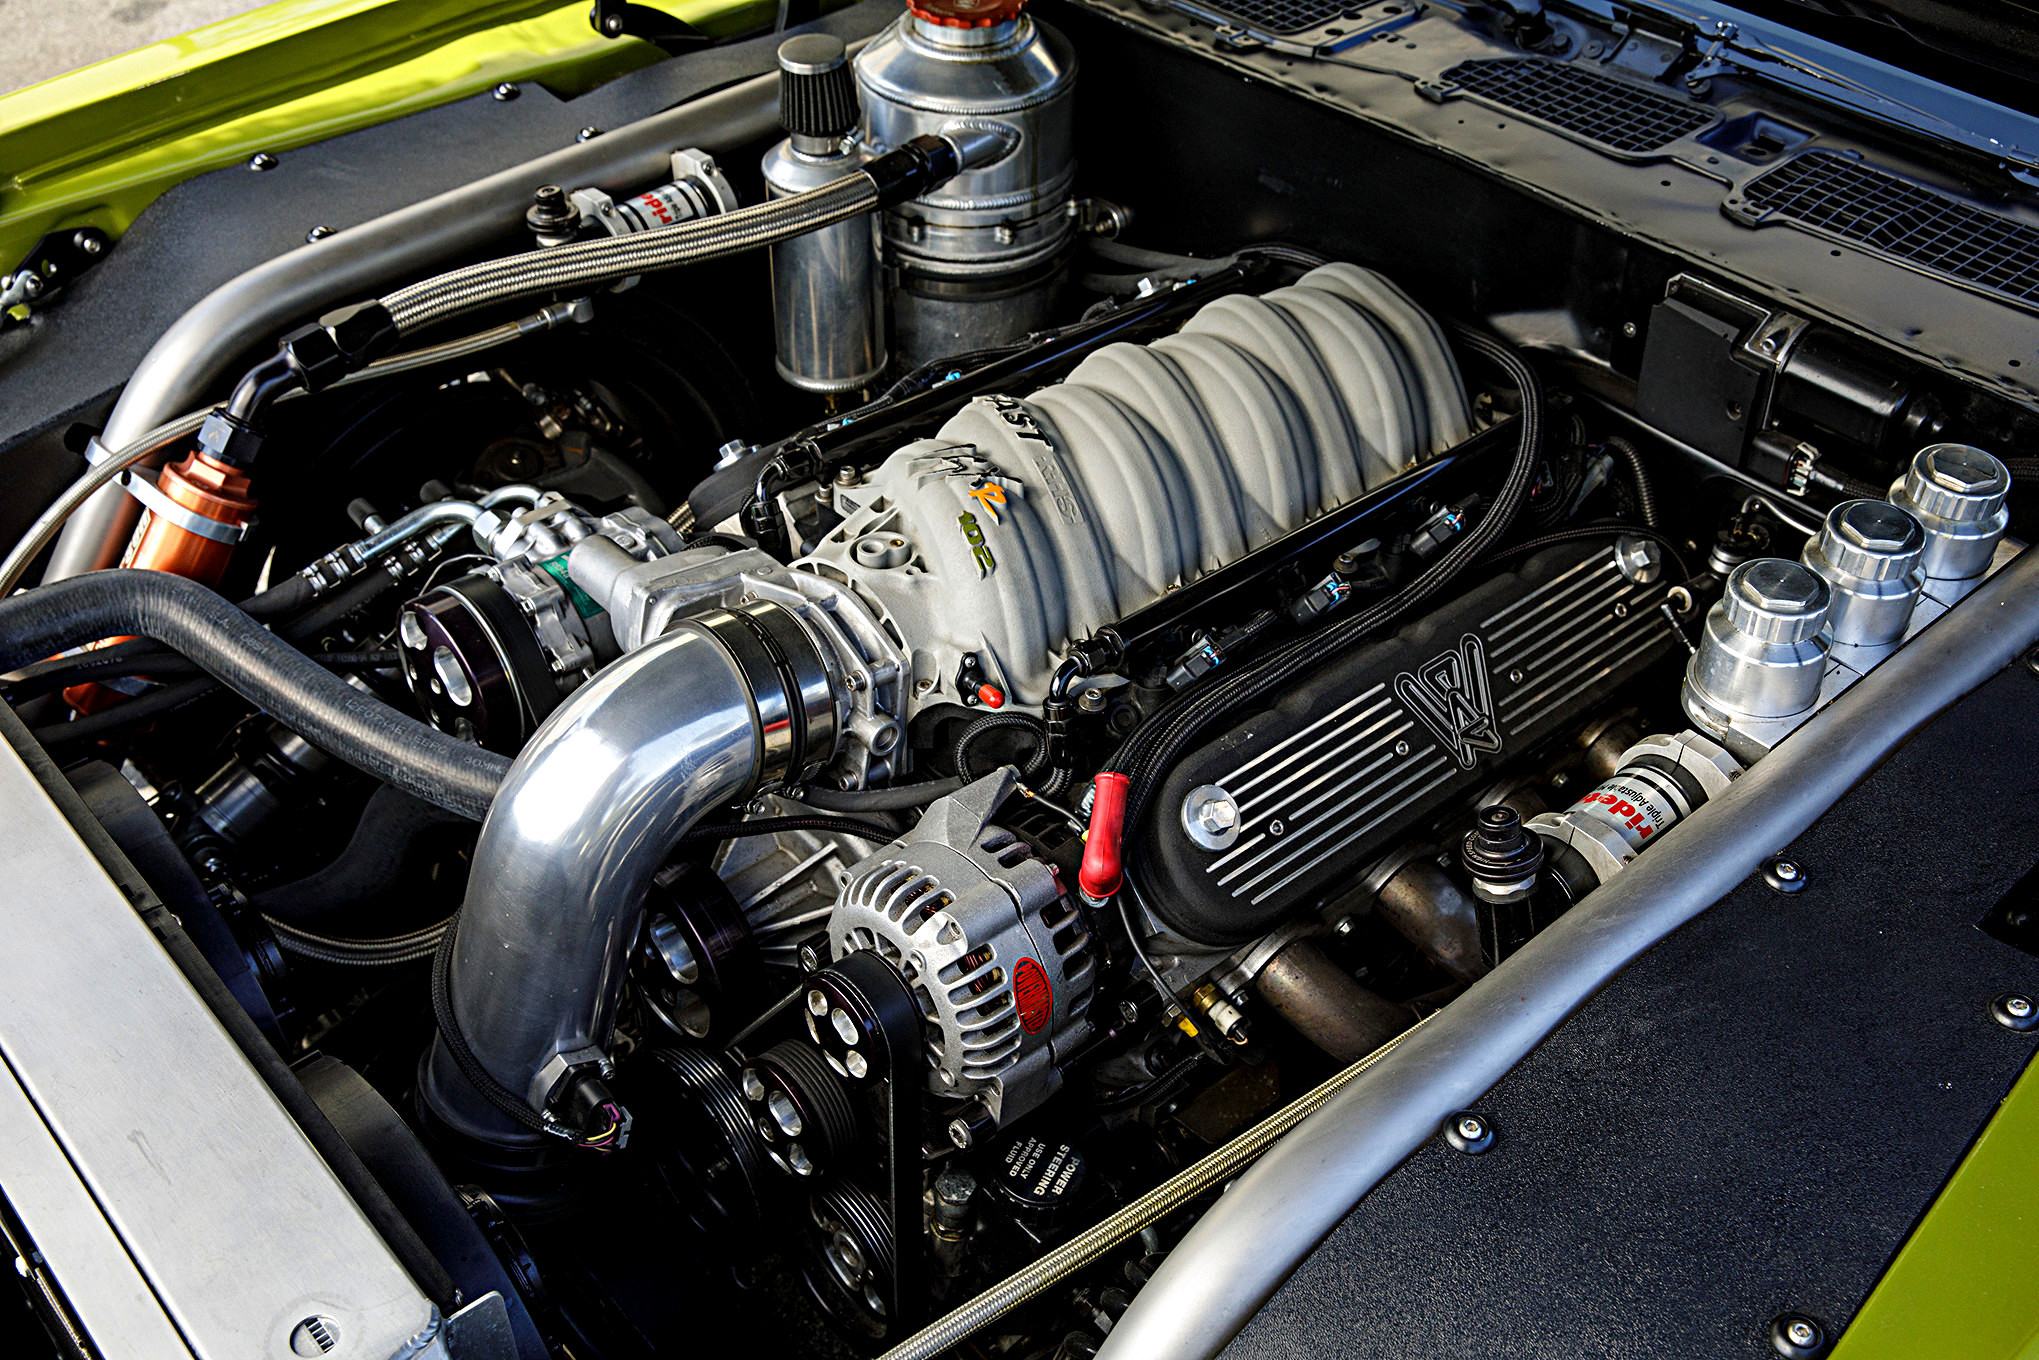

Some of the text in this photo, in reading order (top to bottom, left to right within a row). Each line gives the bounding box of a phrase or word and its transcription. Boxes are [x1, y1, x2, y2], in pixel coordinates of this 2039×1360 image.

[957, 511, 995, 576] 102
[1646, 804, 1666, 830] Triple
[1016, 962, 1050, 1032] POWERMASTER
[1005, 1141, 1023, 1164] FLUID
[1009, 1137, 1037, 1177] APPROVED
[1020, 1143, 1046, 1180] USE ONLY
[1033, 1144, 1071, 1196] STEERING
[1051, 1156, 1081, 1196] POWER
